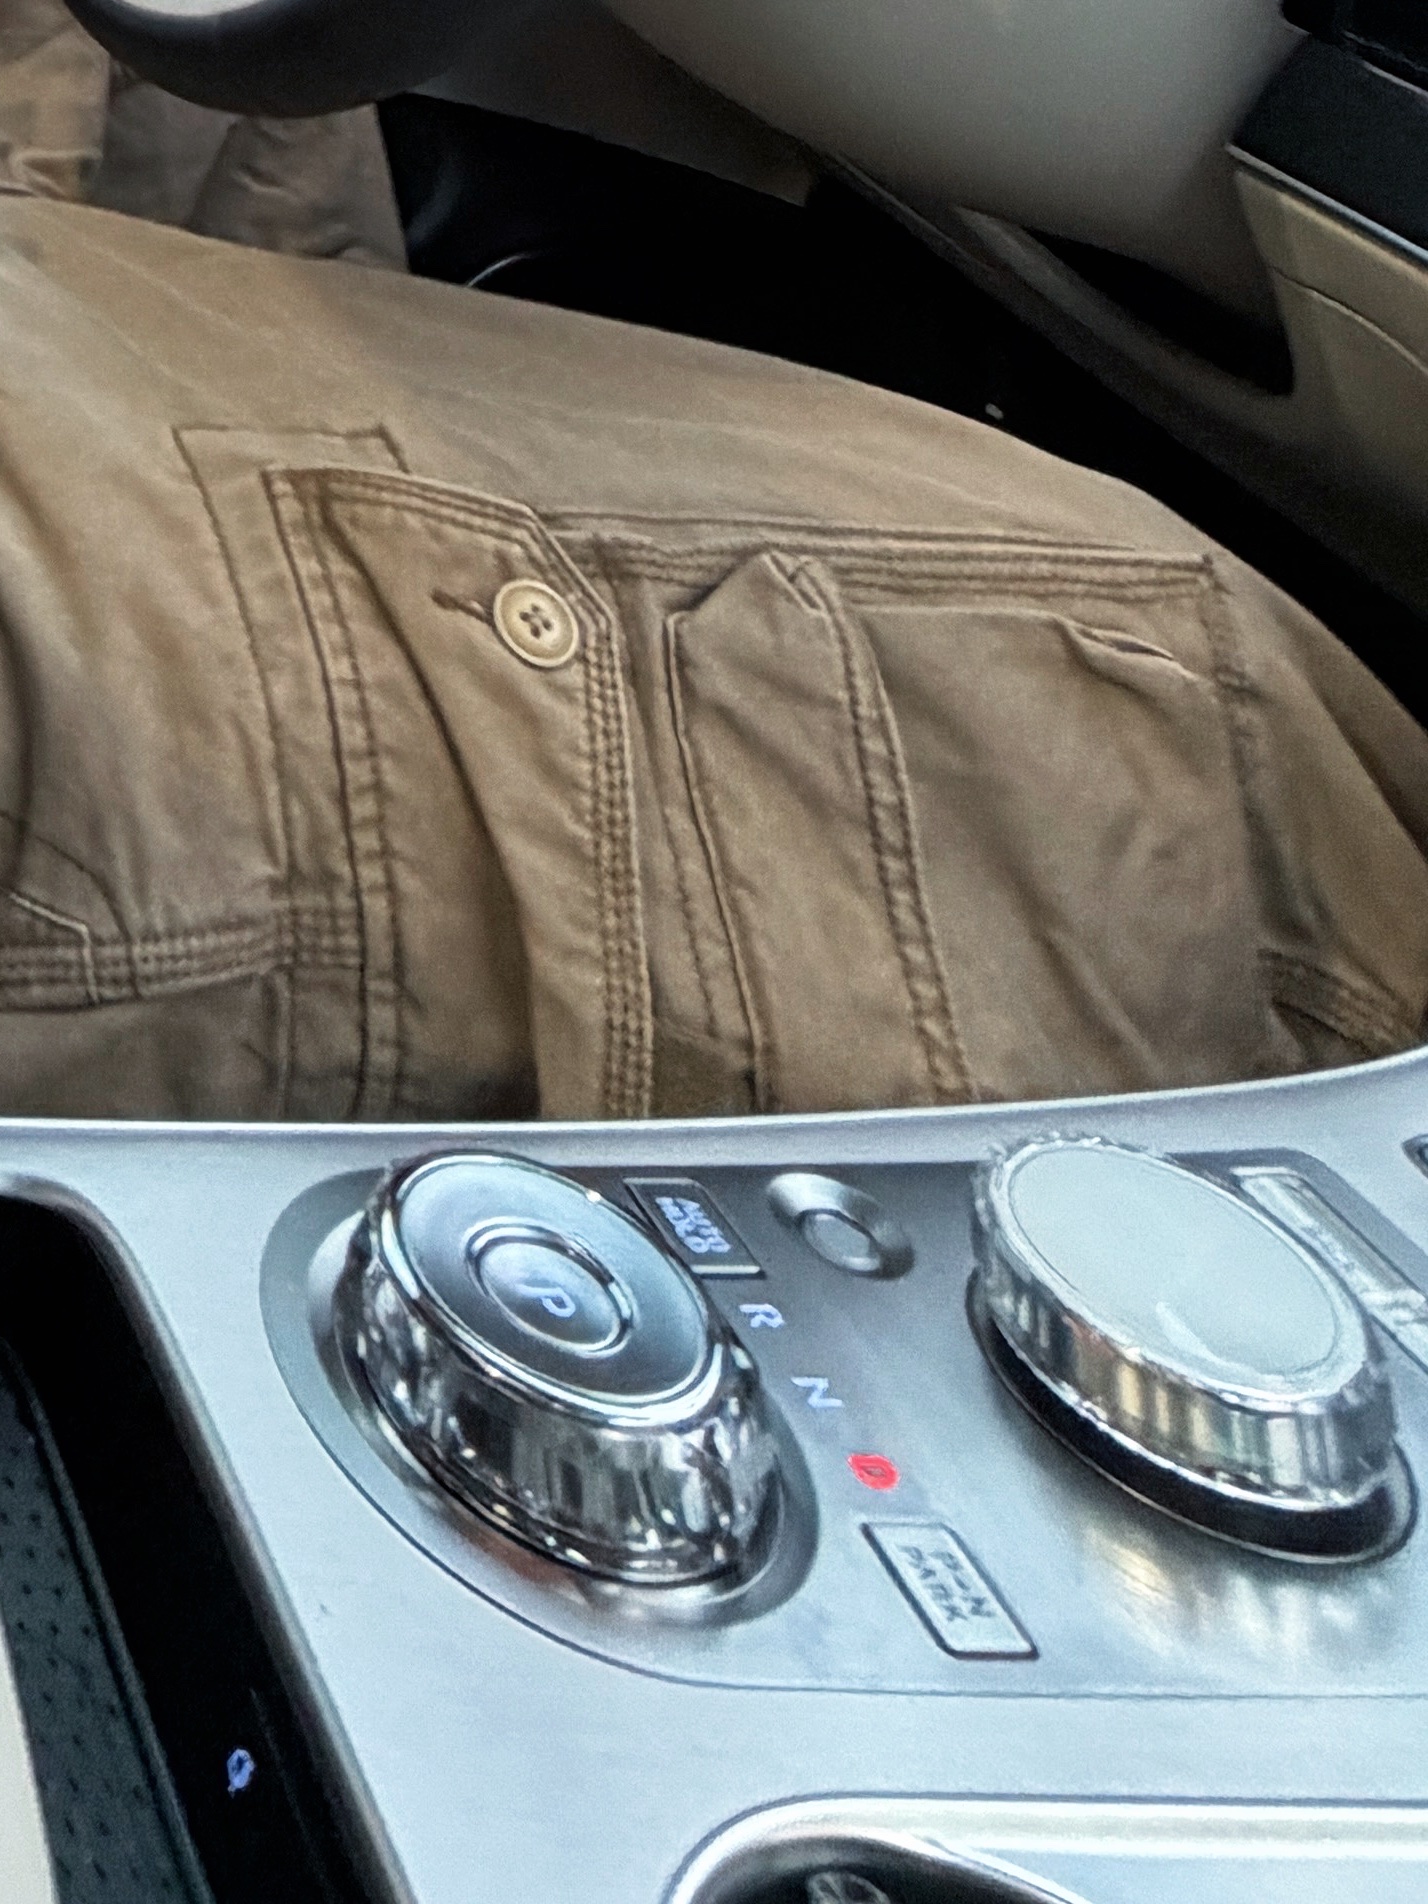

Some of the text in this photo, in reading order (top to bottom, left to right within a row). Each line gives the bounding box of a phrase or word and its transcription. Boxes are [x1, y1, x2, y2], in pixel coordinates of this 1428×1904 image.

[514, 1282, 576, 1318] P
[739, 1303, 785, 1328] R
[790, 1376, 843, 1408] N
[847, 1452, 901, 1491] D
